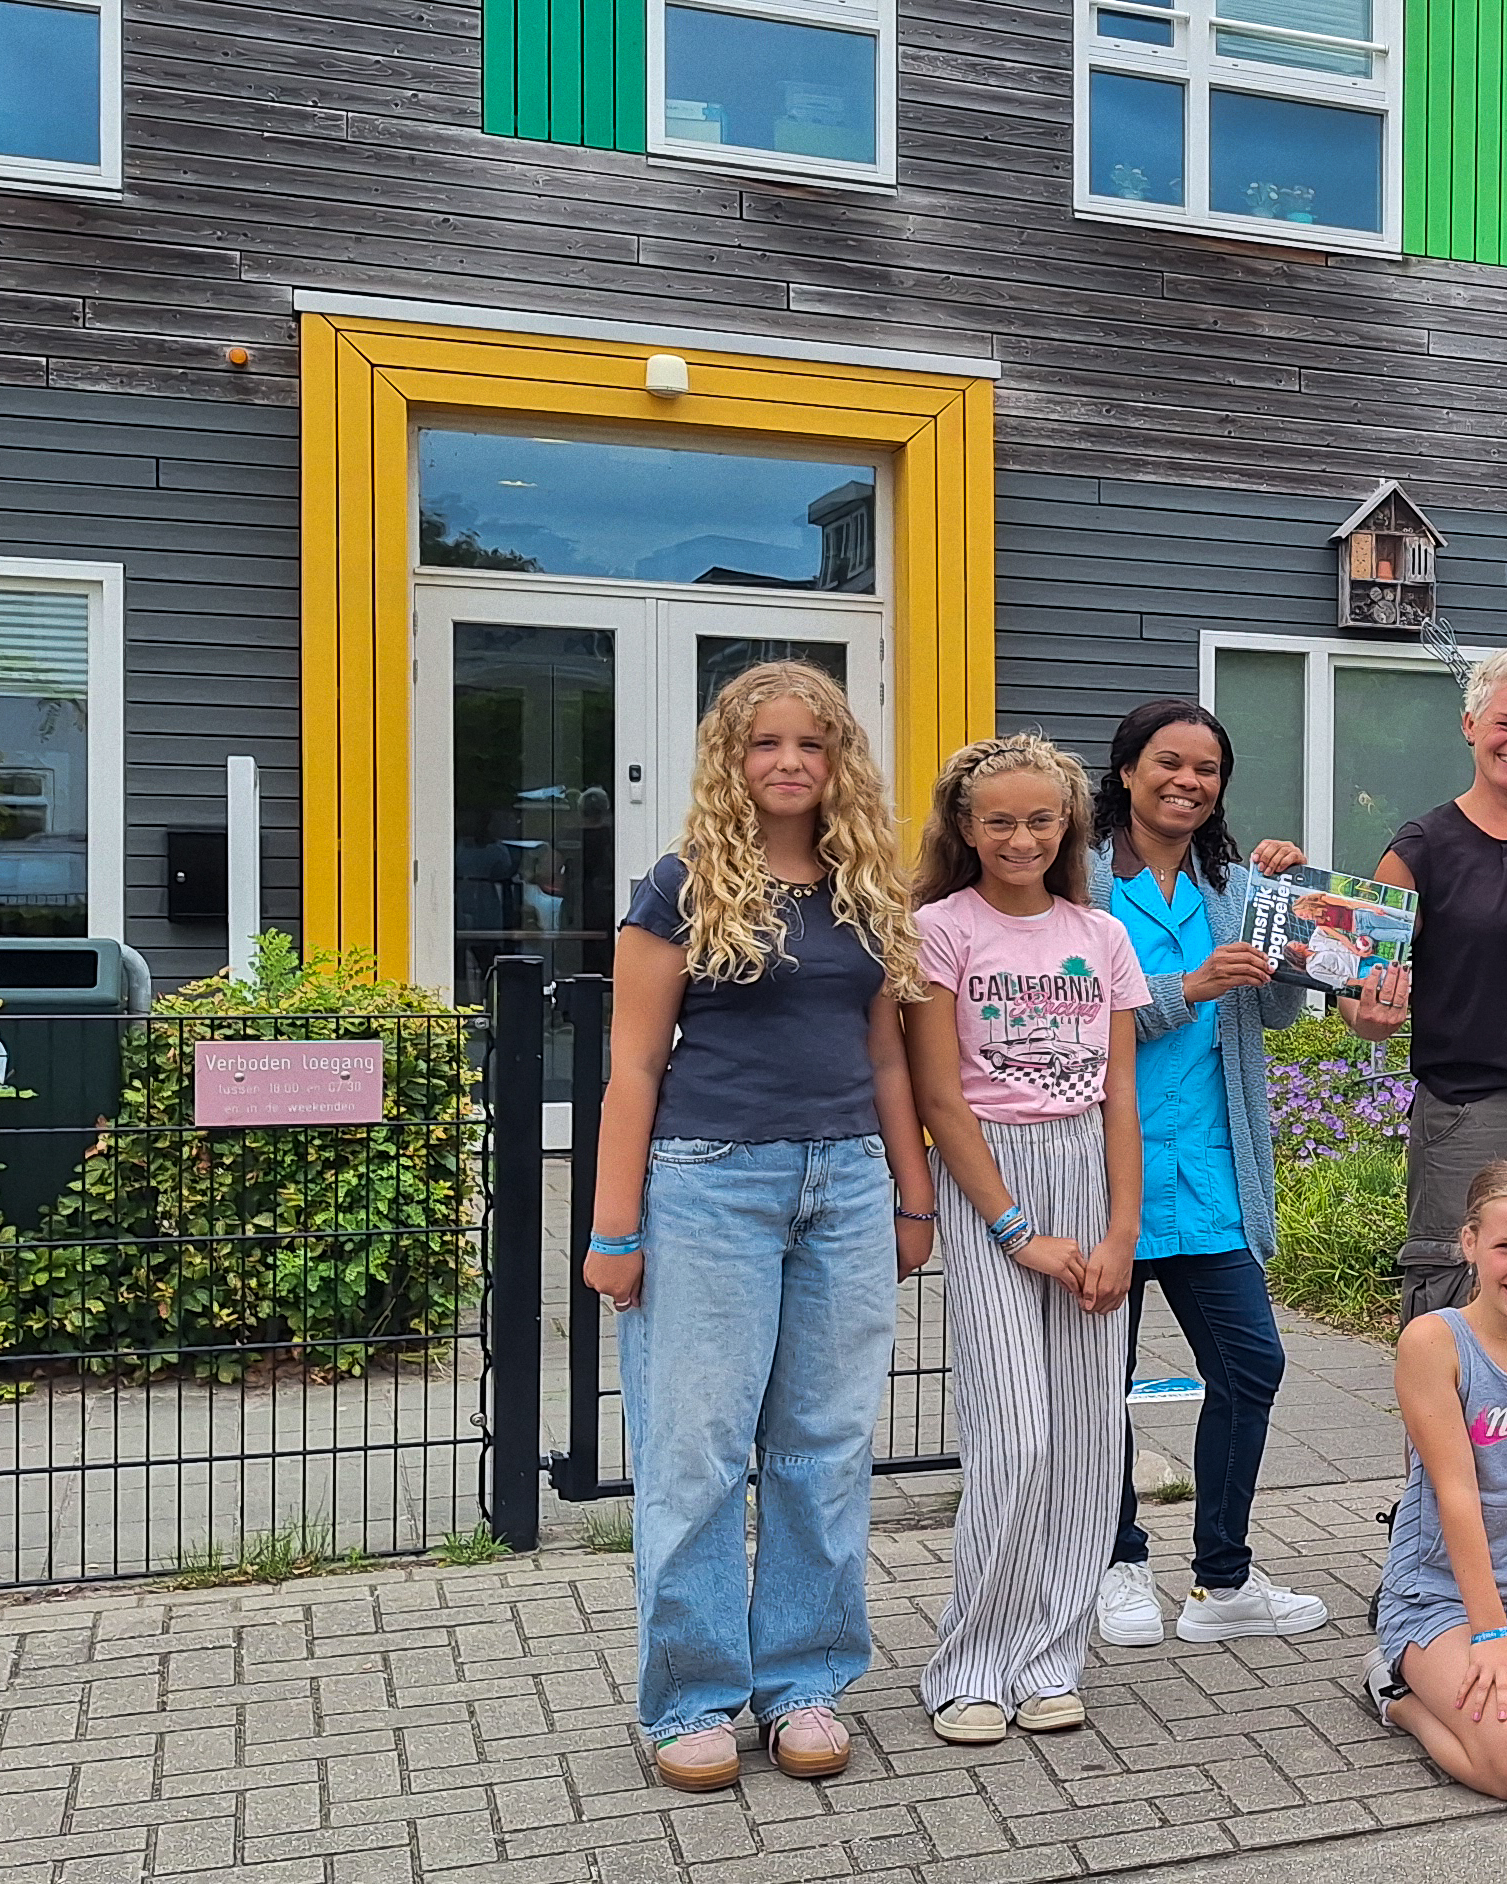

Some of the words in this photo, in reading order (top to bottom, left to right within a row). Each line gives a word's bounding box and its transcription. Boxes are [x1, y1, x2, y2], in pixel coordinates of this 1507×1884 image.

[1251, 886, 1276, 952] ansrijk
[1267, 873, 1293, 973] opgroeien
[205, 1054, 291, 1071] Verboden
[302, 1053, 374, 1075] toegang
[287, 1101, 355, 1113] weekenden
